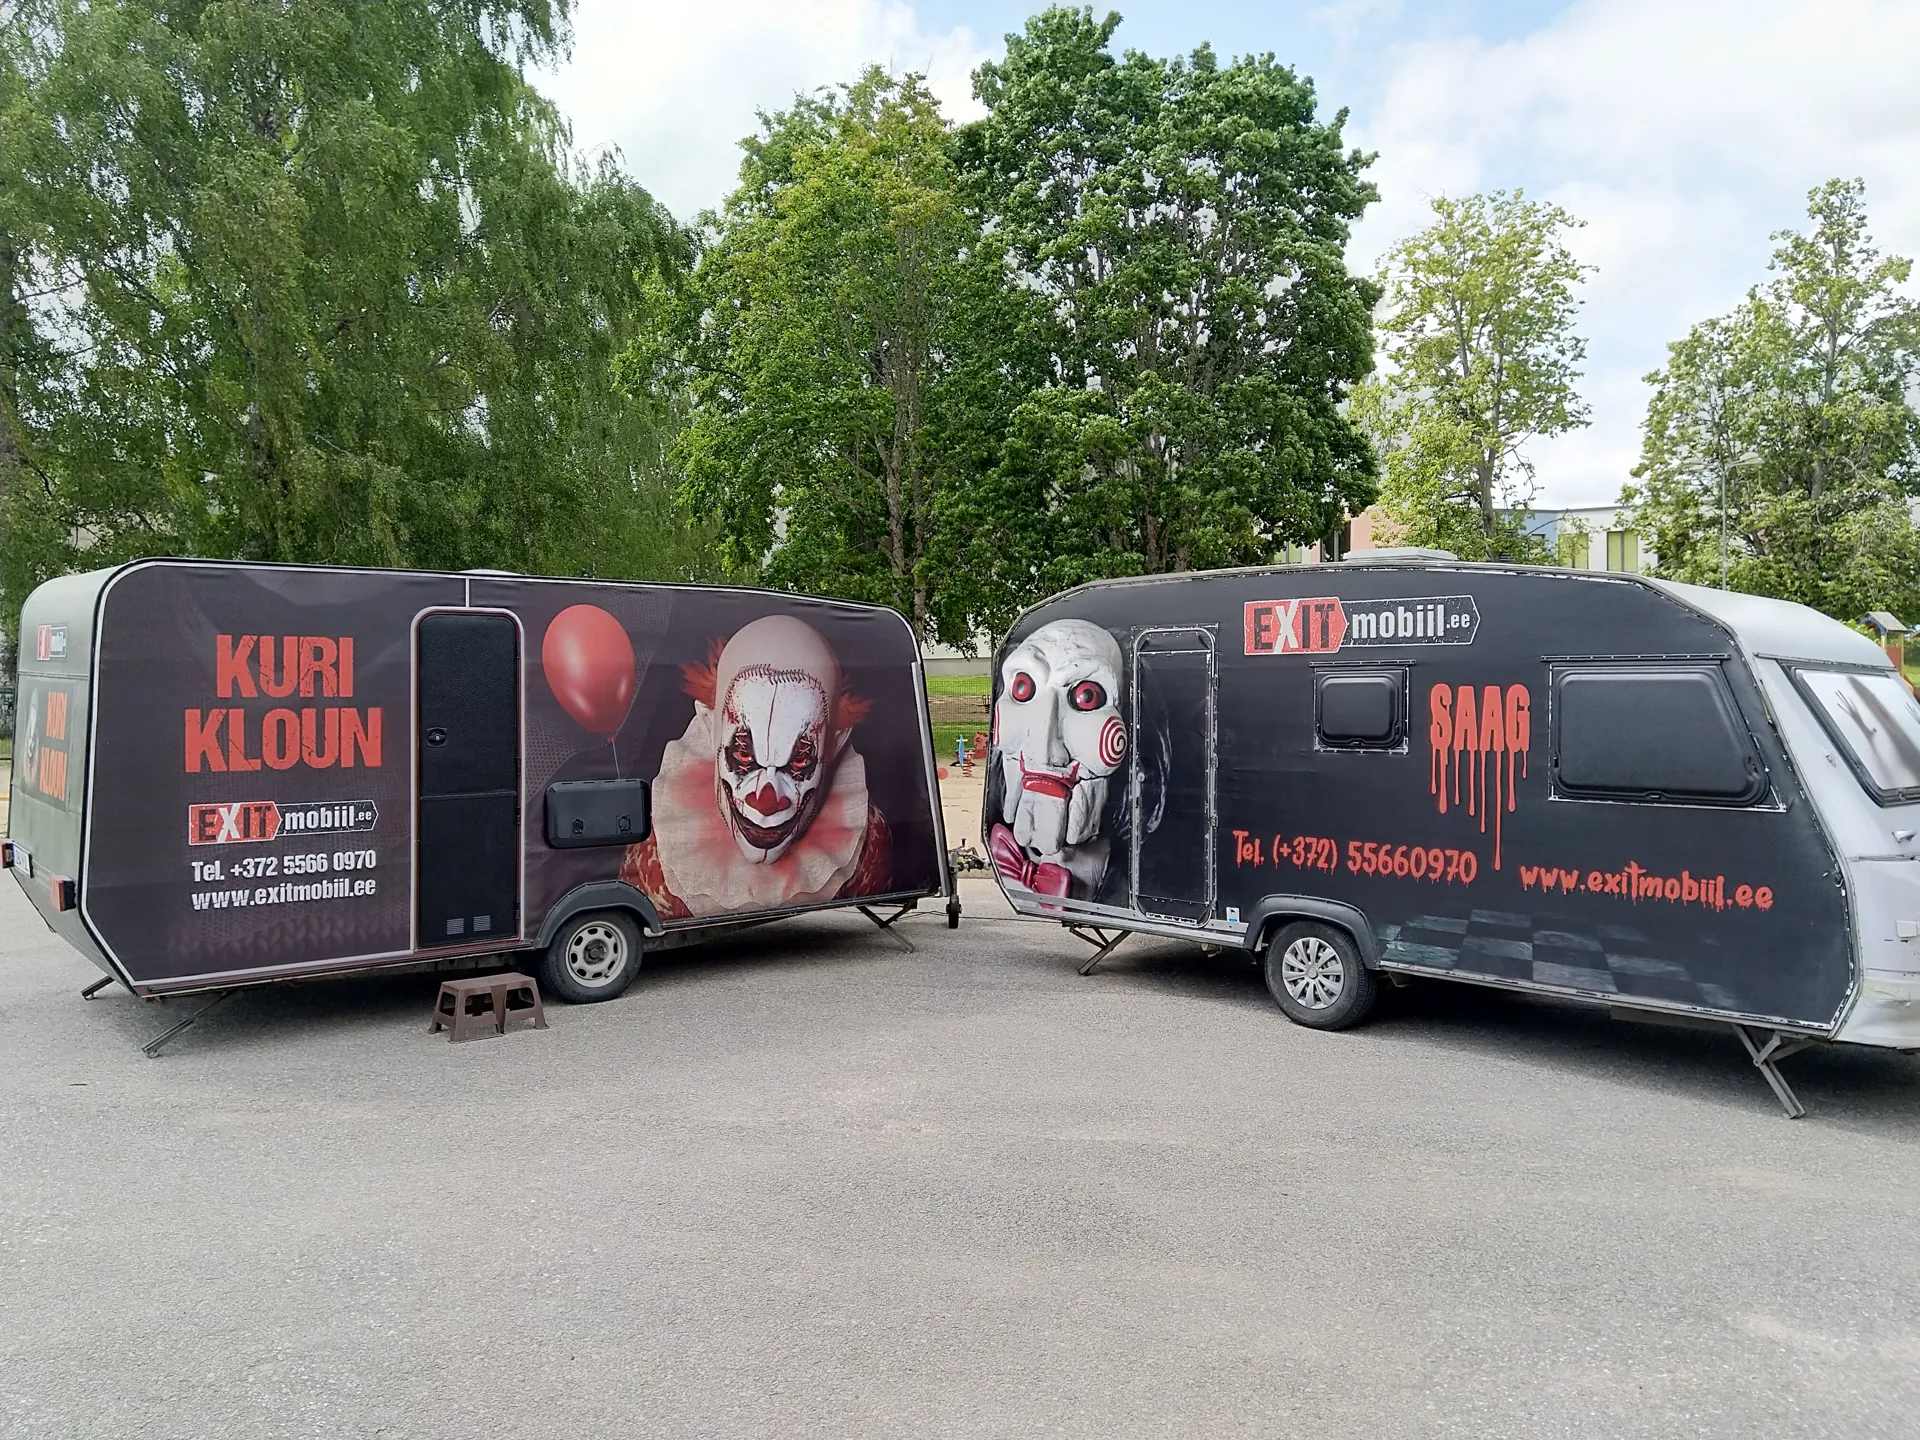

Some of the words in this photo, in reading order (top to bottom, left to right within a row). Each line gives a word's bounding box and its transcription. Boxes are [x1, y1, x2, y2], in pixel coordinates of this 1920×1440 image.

[1253, 600, 1336, 654] EXIT
[1351, 604, 1471, 639] mobiil.ee
[216, 634, 354, 698] KURI
[184, 707, 383, 773] KLOUN
[200, 803, 272, 844] EXIT
[284, 805, 372, 831] mobiil.ee
[191, 861, 225, 882] Tel.
[230, 856, 278, 880] +372
[283, 853, 329, 875] 5566
[333, 850, 377, 871] 0970
[1232, 830, 1265, 868] Tel.
[1272, 834, 1339, 875] (+372)
[1347, 841, 1478, 888] 55660970
[191, 878, 376, 911] www.exitmobiil.ee
[1519, 861, 1774, 913] www.exitmobiil.ee
